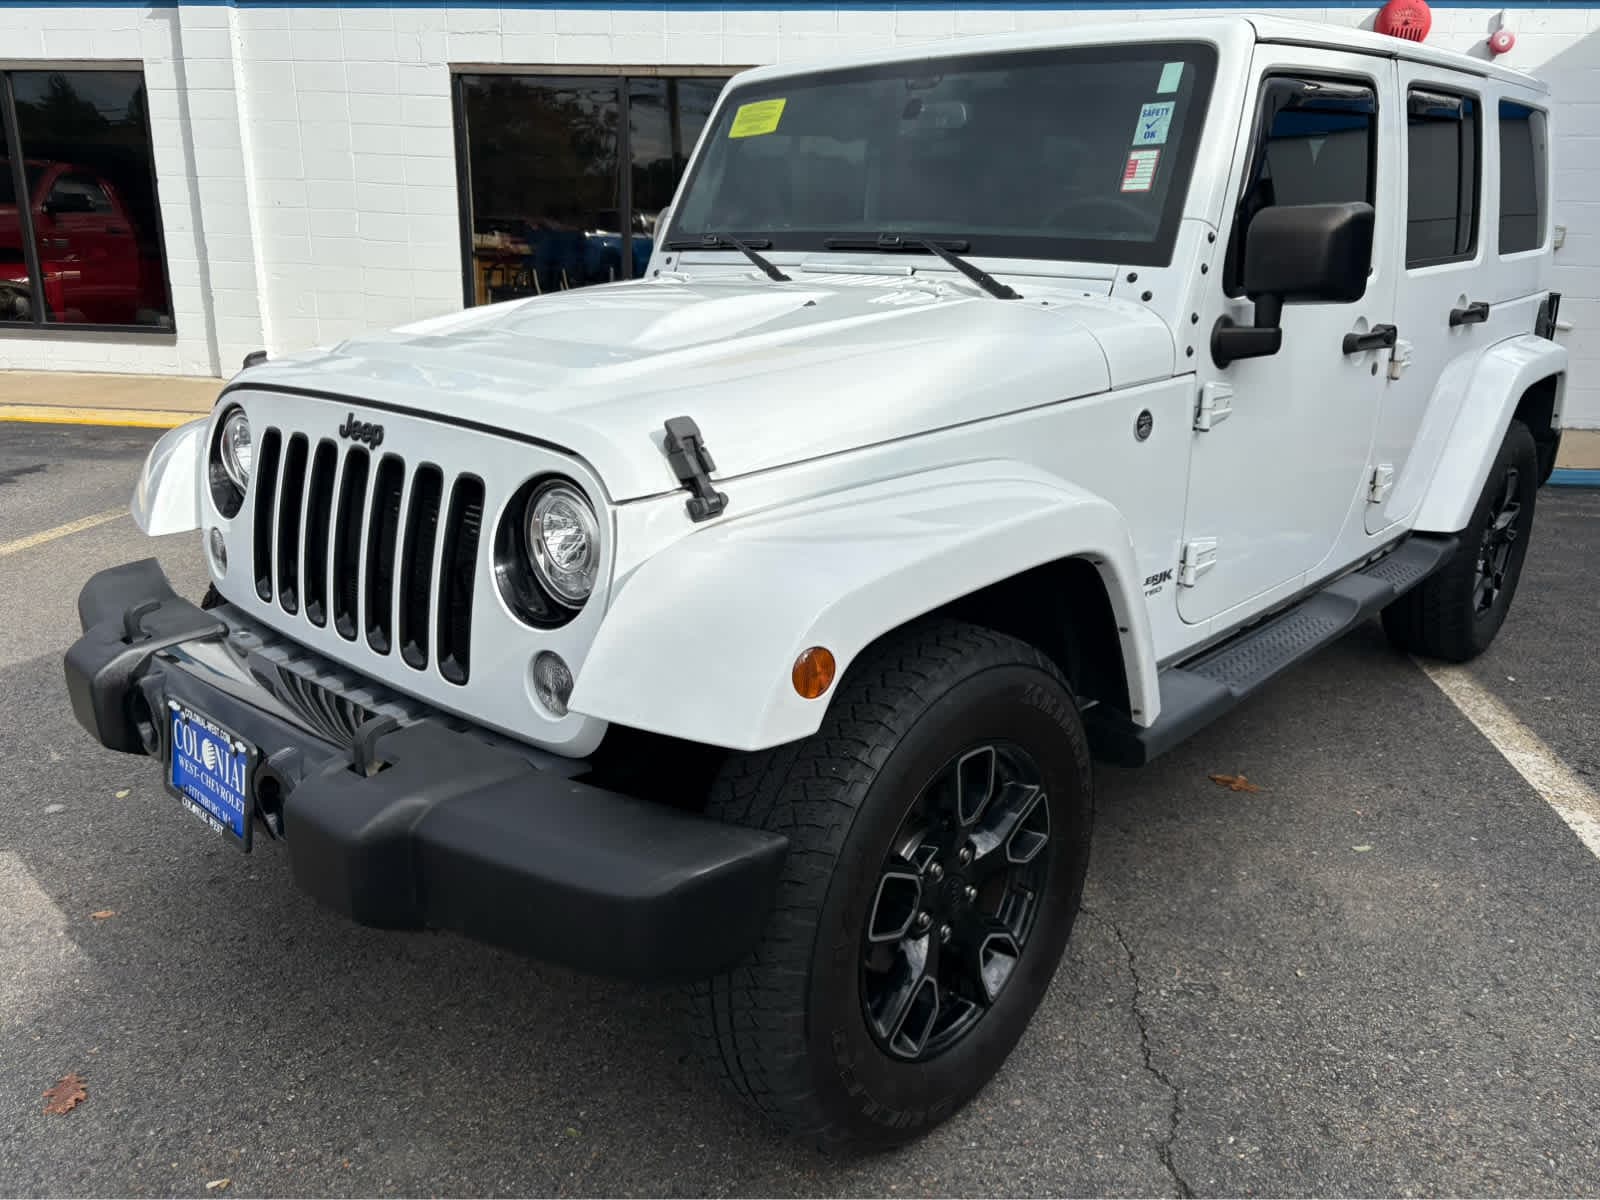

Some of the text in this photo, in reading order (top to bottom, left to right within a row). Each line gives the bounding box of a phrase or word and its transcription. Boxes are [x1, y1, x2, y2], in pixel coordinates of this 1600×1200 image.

[1142, 107, 1170, 118] SAFETY
[1143, 130, 1157, 140] OK
[339, 412, 384, 450] Jeep
[200, 771, 244, 815] CHEVROLET
[209, 816, 223, 836] WEST
